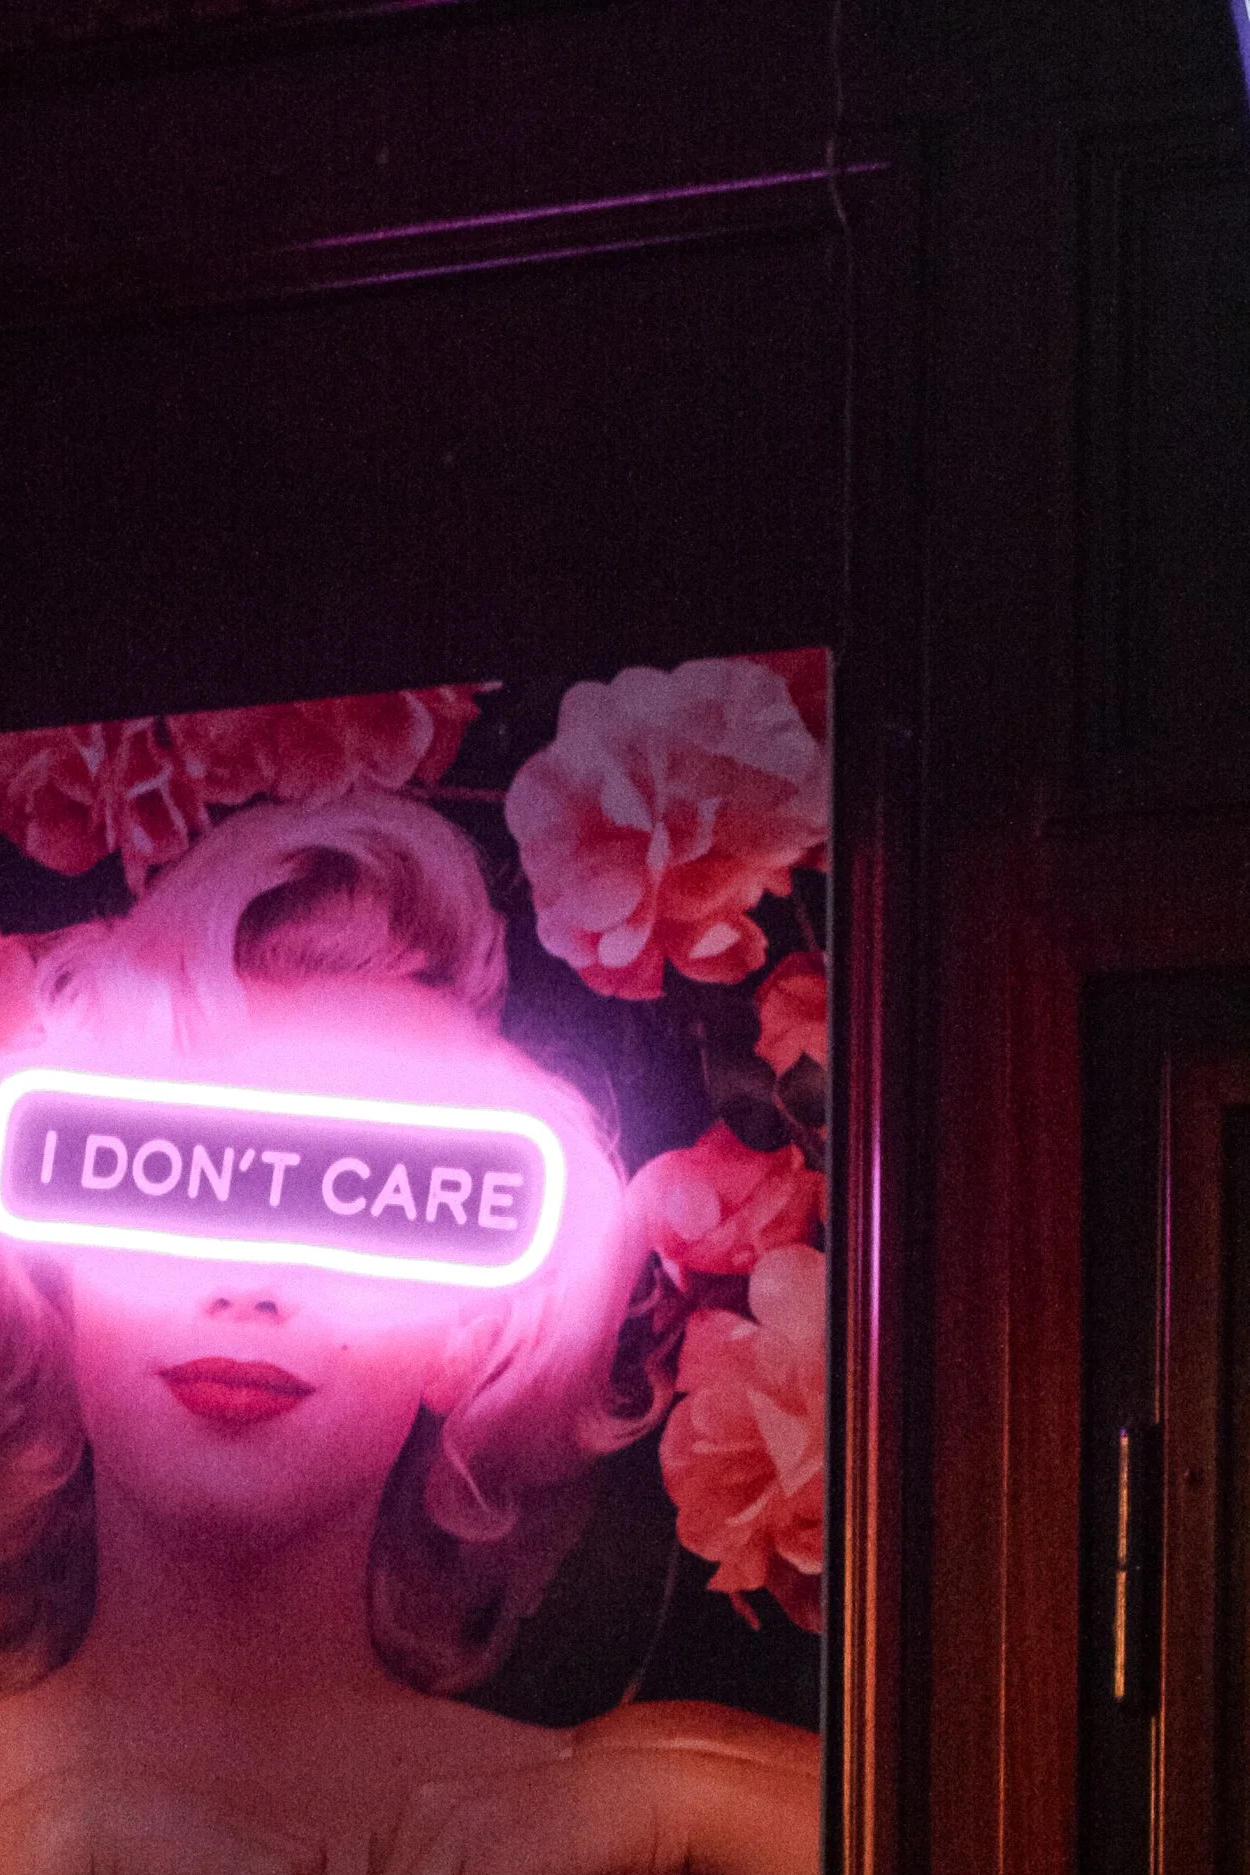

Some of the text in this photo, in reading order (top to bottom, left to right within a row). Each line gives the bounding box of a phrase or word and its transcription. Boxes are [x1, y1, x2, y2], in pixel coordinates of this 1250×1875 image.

[40, 1130, 524, 1232] I DON'T CARE
